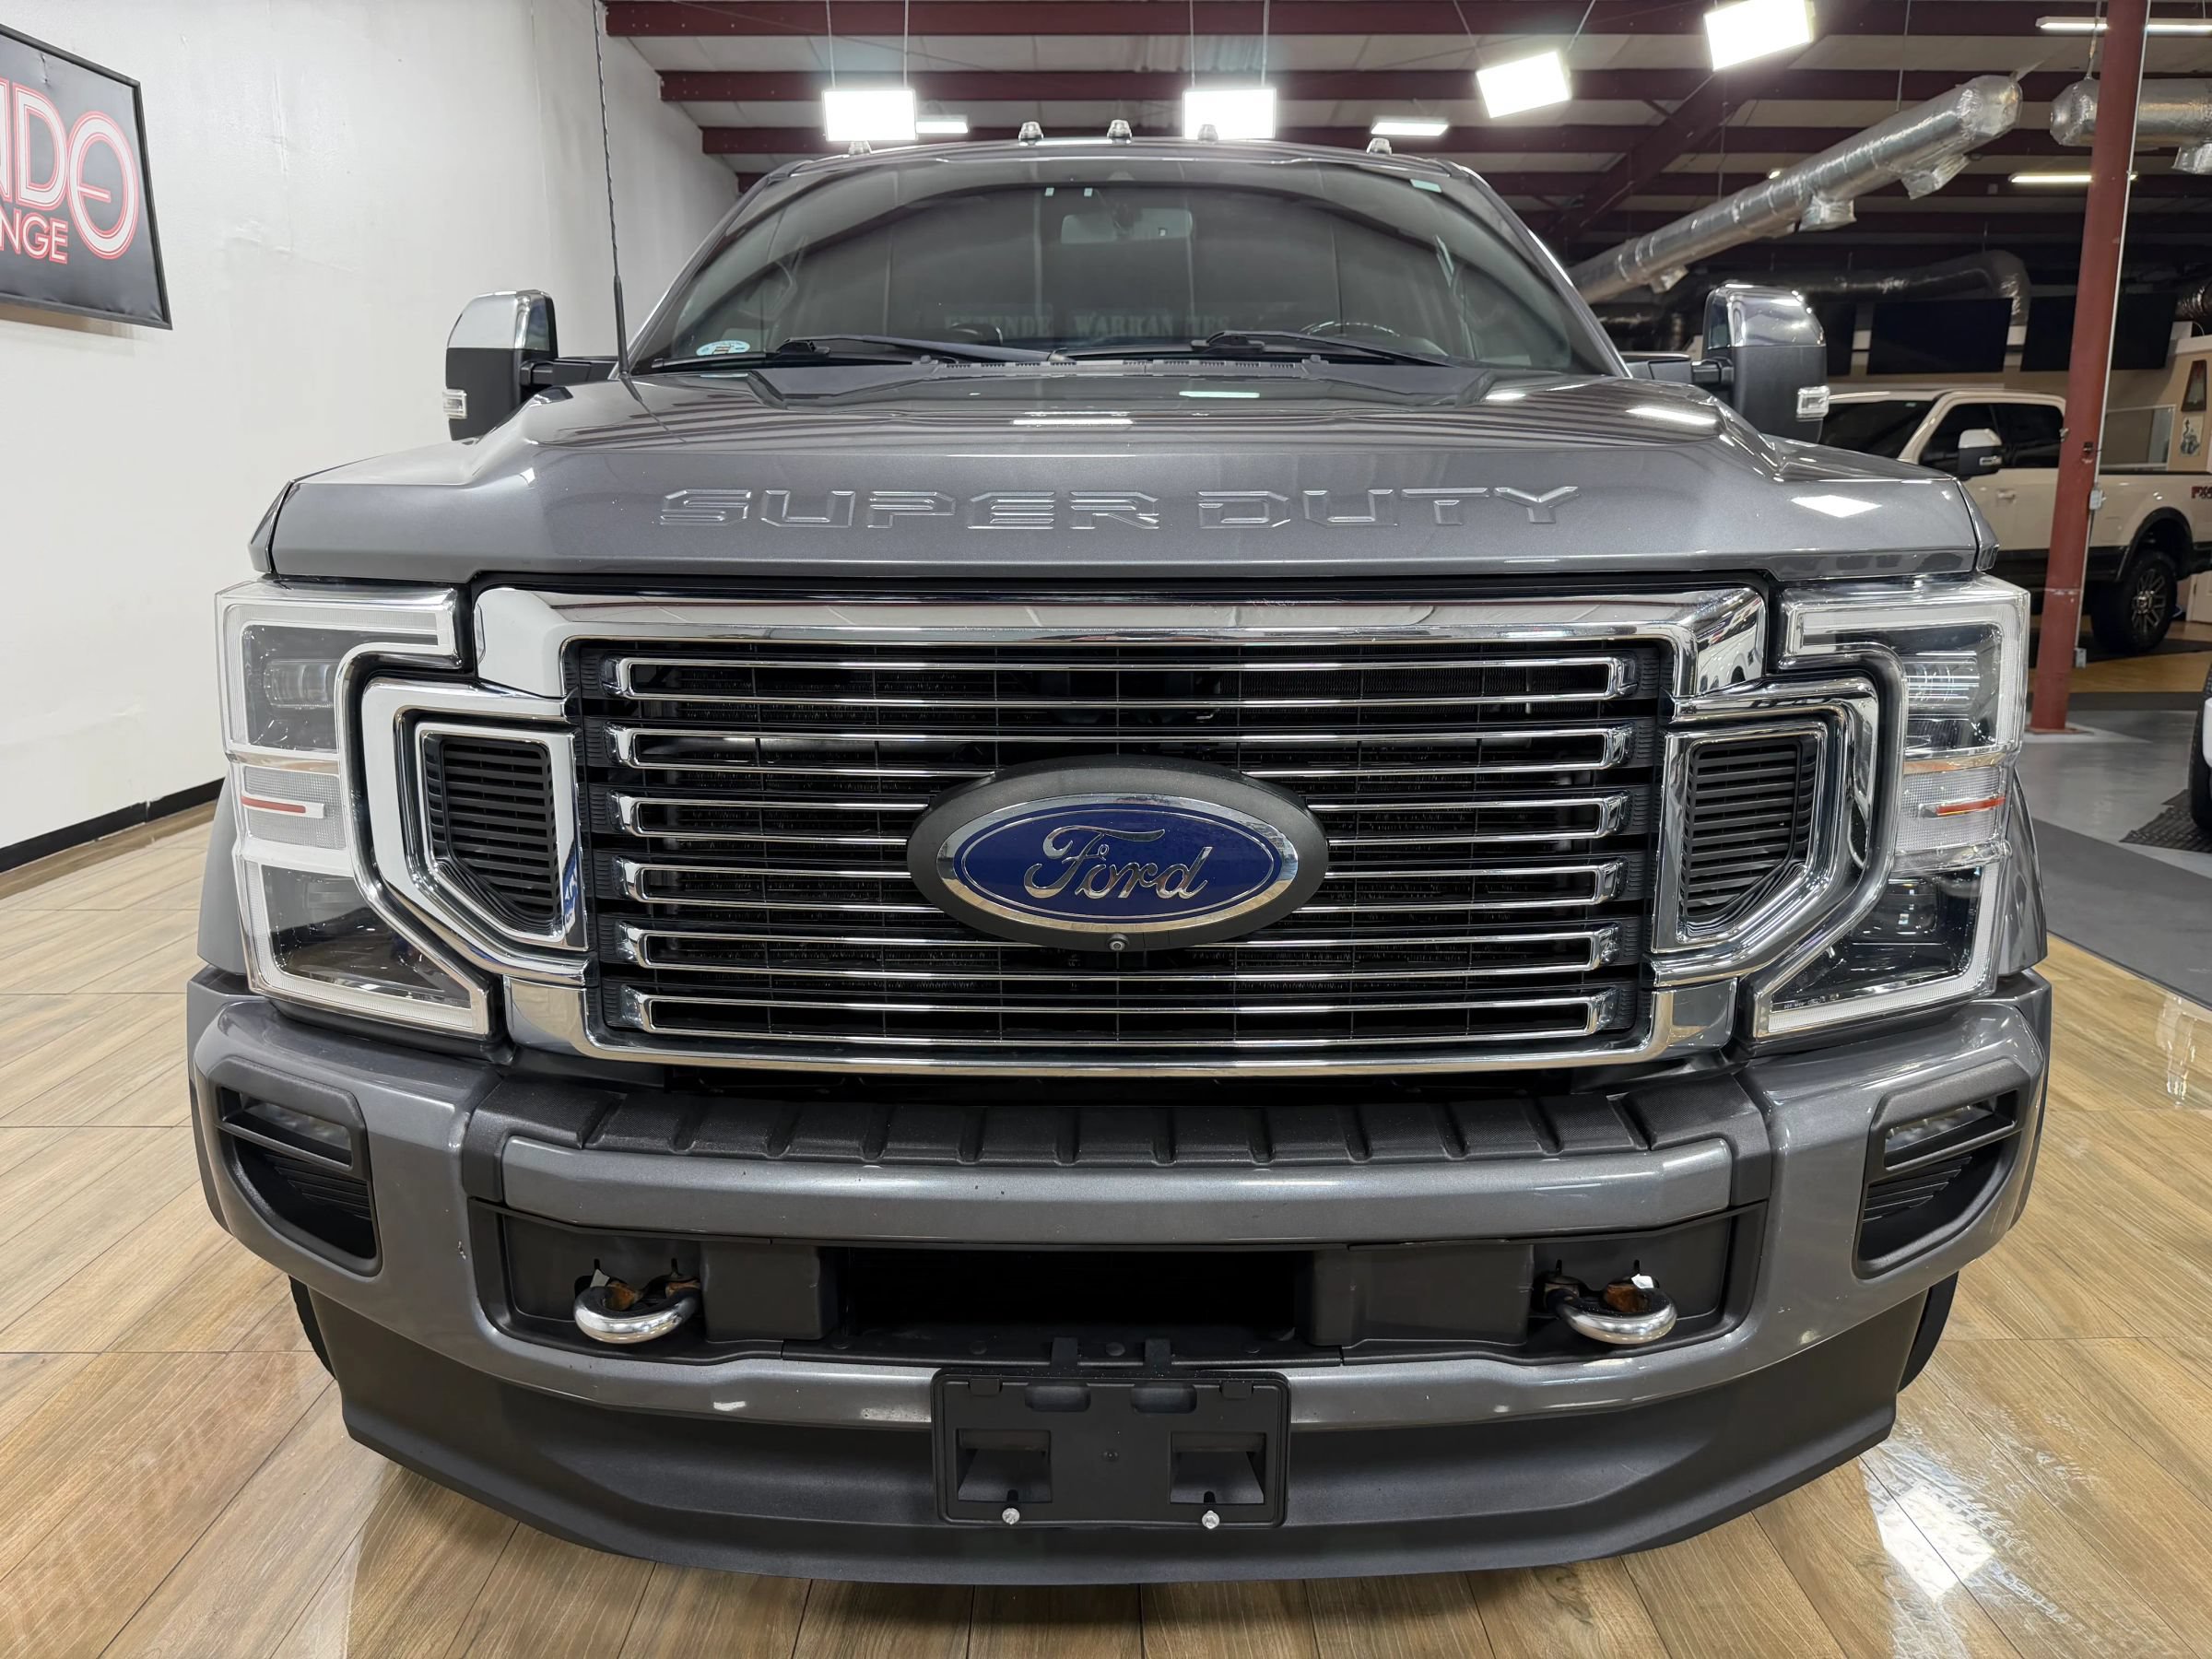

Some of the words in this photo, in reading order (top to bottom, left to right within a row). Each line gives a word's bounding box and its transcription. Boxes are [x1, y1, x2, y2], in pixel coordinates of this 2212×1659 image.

[660, 489, 1162, 531] SUPER
[1196, 486, 1581, 529] DUTY
[1024, 824, 1213, 900] Ford
